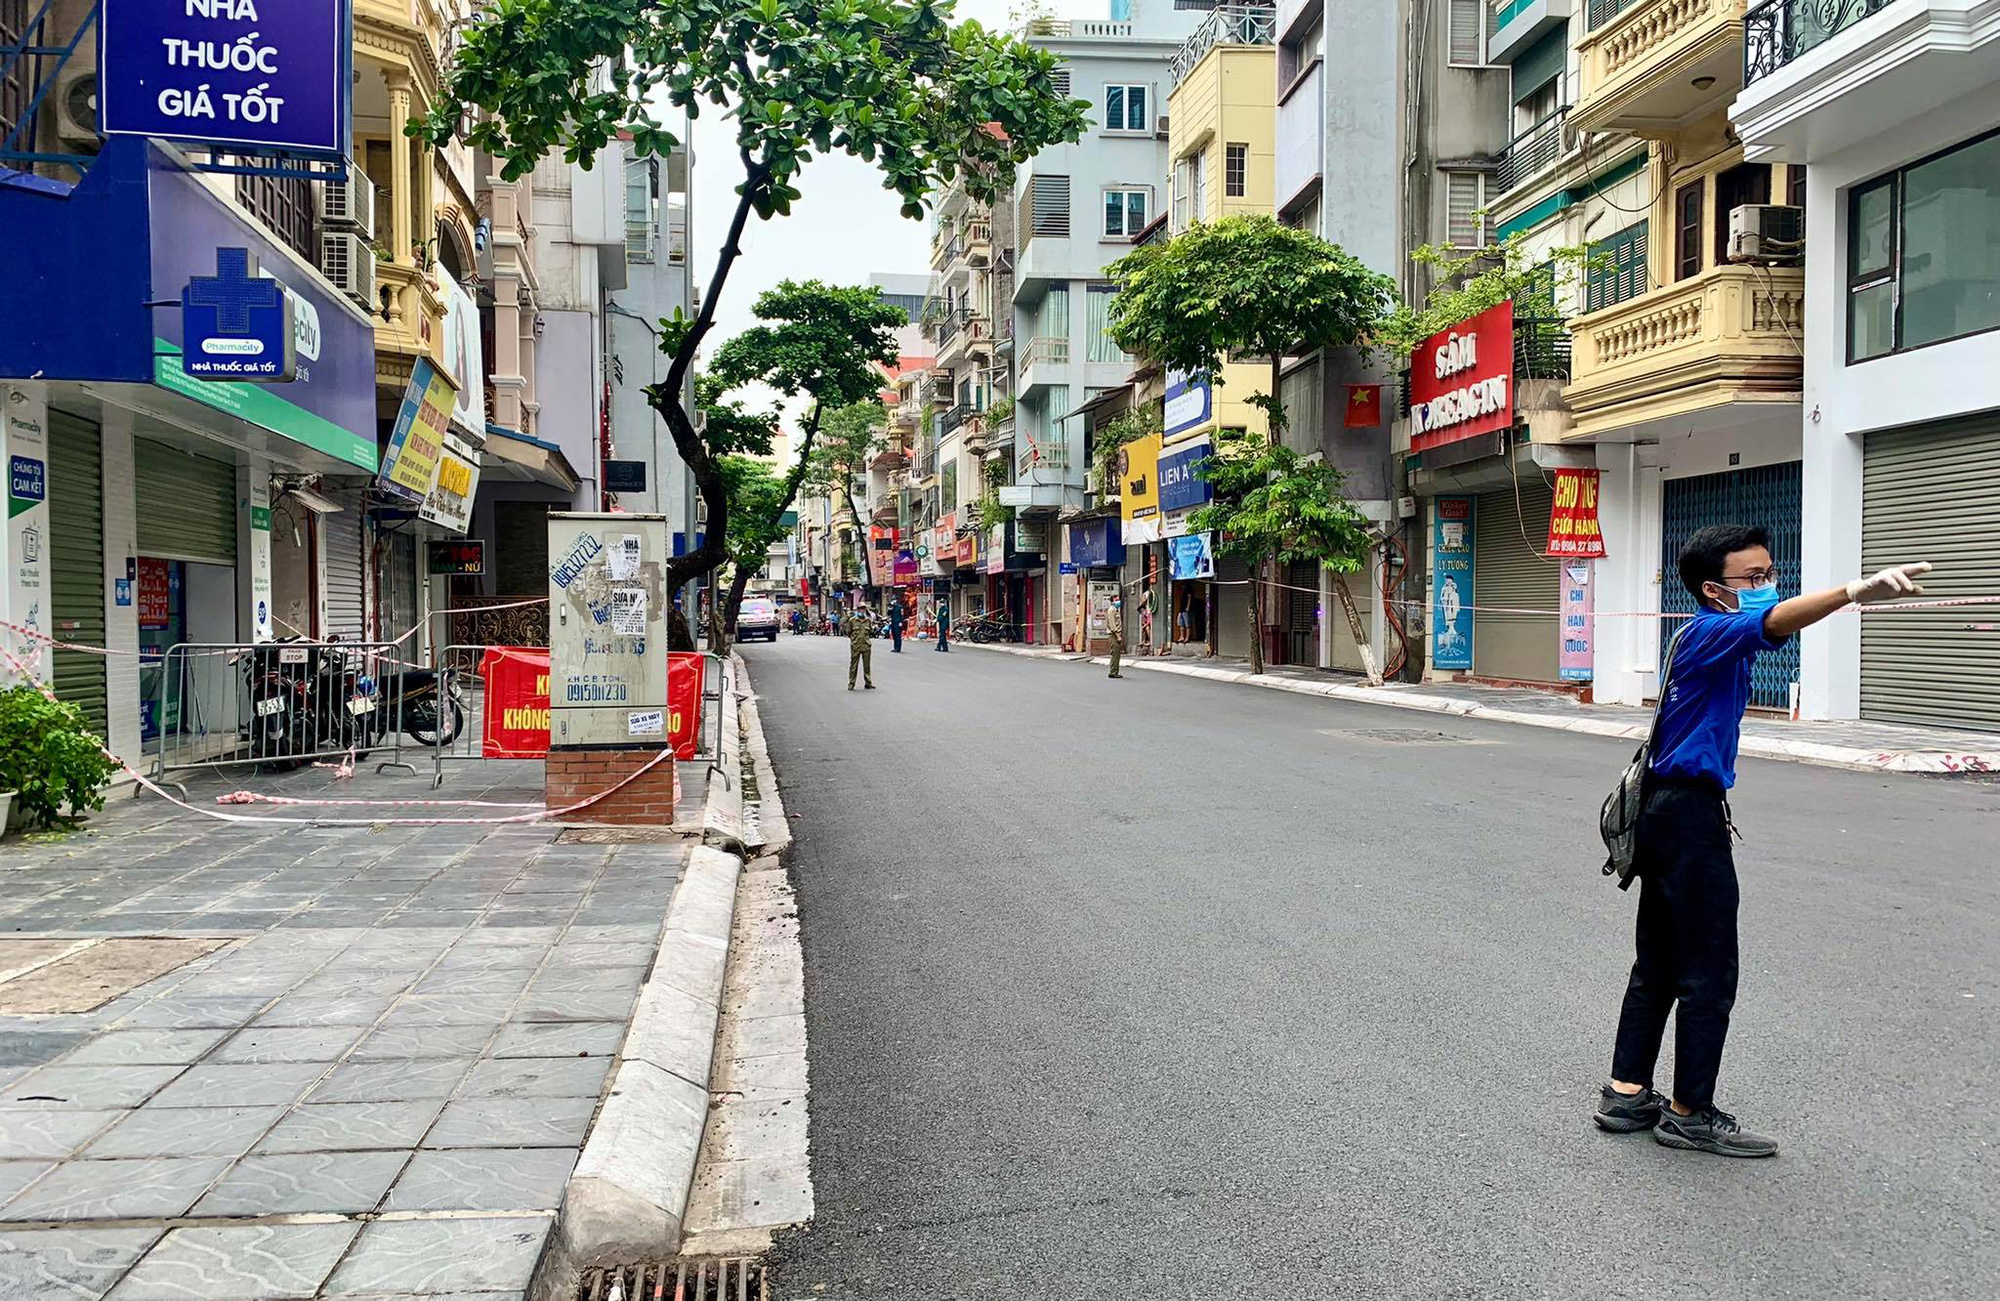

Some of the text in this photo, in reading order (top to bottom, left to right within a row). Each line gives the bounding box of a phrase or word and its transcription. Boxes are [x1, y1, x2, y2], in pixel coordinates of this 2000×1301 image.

[162, 32, 278, 74] THUỐC
[158, 82, 284, 124] GIÁ TỐT
[206, 341, 260, 352] Pharmacity
[1435, 332, 1477, 379] SÂM
[192, 361, 276, 372] NHÀ THUỐC GIÁ TỐT
[13, 478, 30, 492] CAM
[1555, 475, 1578, 508] CHO
[1553, 513, 1573, 534] CỬA
[551, 535, 603, 589] 0915327232
[1570, 590, 1584, 601] CHI
[567, 684, 627, 701] 0915011230
[504, 706, 550, 730] KHÔNG
